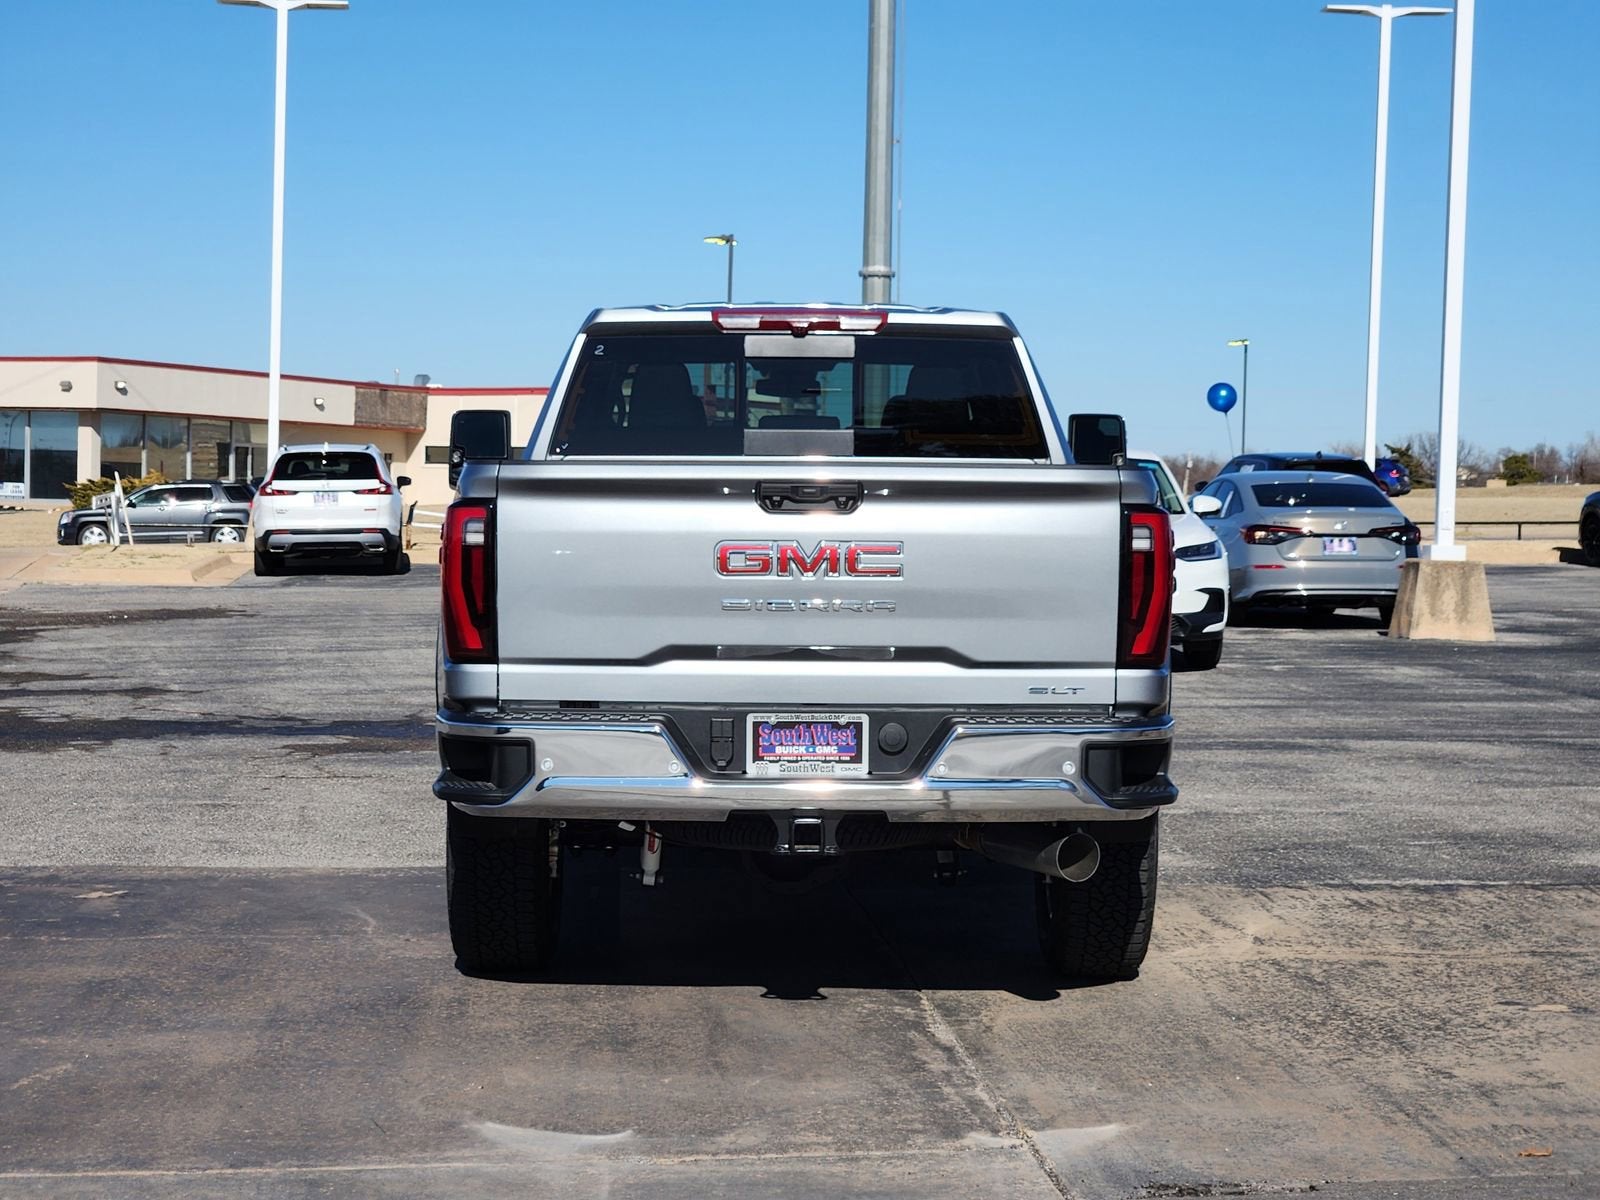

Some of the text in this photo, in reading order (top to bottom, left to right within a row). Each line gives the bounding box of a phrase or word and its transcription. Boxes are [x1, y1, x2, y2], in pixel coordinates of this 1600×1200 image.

[594, 344, 605, 355] 2
[714, 539, 904, 581] GMC
[720, 598, 897, 612] SIERRA
[1028, 687, 1085, 695] SLT
[775, 745, 839, 754] BUICK GMC
